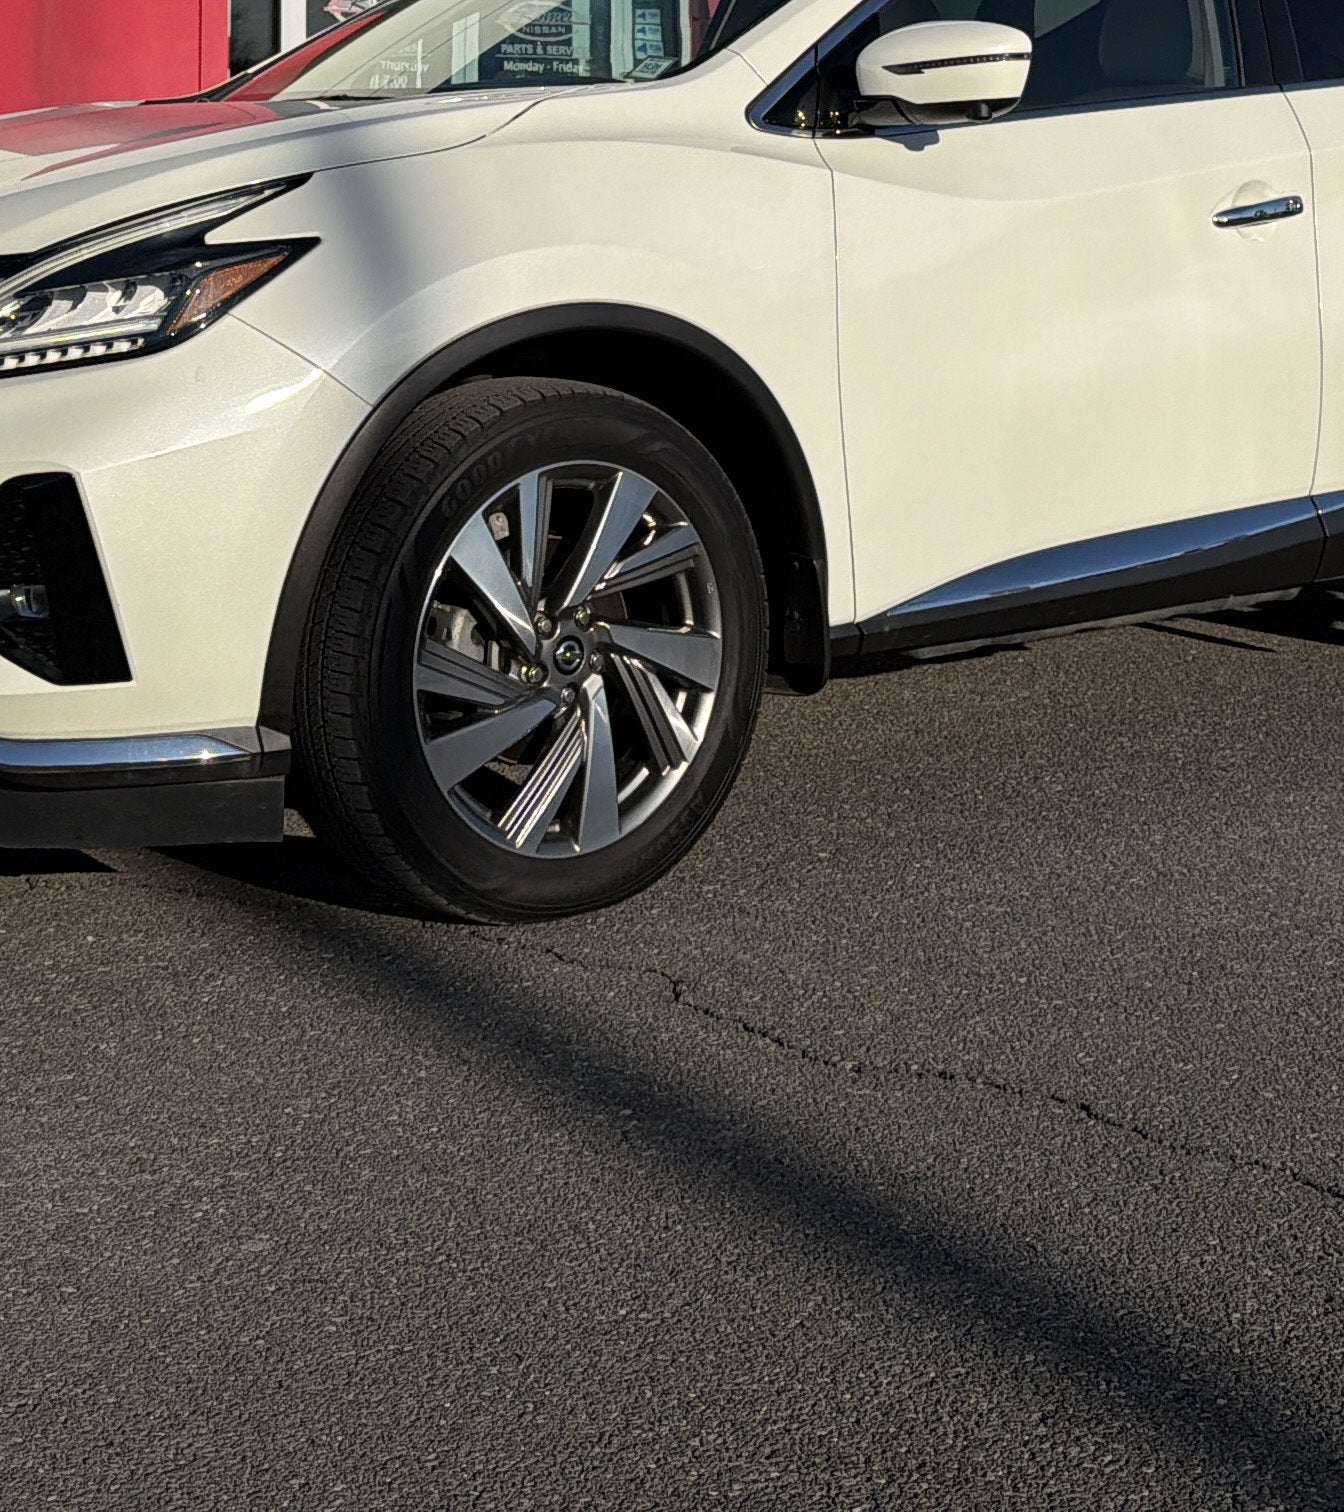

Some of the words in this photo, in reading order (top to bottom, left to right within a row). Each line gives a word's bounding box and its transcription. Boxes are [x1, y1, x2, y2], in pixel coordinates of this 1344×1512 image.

[522, 26, 566, 34] NISSAN
[501, 44, 534, 55] PARTS
[546, 45, 574, 56] SERV
[504, 60, 545, 74] Monday
